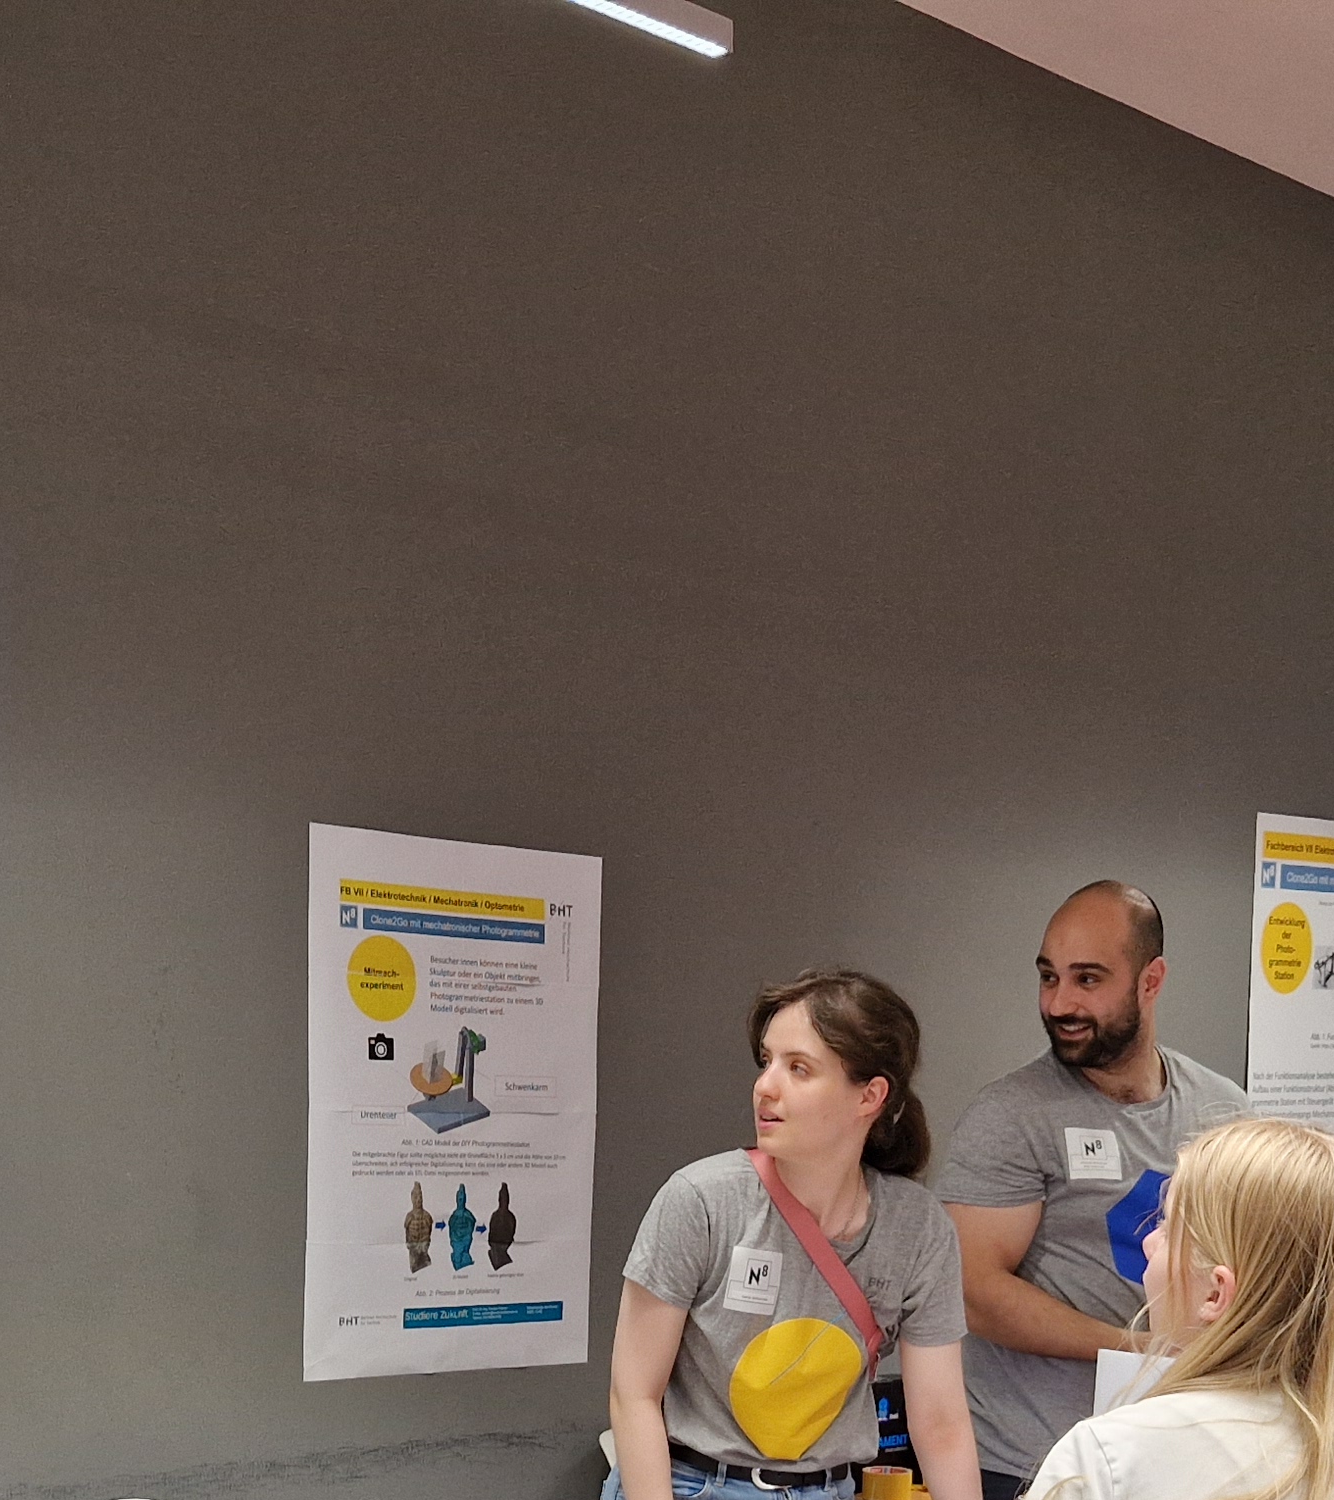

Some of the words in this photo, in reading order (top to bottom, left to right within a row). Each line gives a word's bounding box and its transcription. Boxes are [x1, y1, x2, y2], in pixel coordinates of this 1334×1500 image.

[340, 886, 352, 896] FB
[371, 889, 427, 903] Elektrotechnik
[433, 896, 478, 909] Mechatronik
[485, 900, 525, 913] Optometrie
[549, 903, 573, 918] BHT
[371, 914, 408, 927] Clone2Go
[410, 920, 422, 929] mit
[423, 920, 481, 933] mechatronischer
[481, 924, 540, 938] Photogrammetrie
[1269, 916, 1306, 929] Entwicklung
[1281, 930, 1292, 940] der
[479, 959, 504, 968] können
[520, 962, 538, 970] kleine
[429, 968, 456, 977] Skulptur
[485, 972, 505, 981] Objekt
[1274, 970, 1295, 980] Station
[360, 982, 404, 991] experiment
[430, 1004, 453, 1012] Modell
[505, 1082, 549, 1092] Schwenkarm
[869, 1276, 892, 1291] BHT
[339, 1316, 360, 1327] BHT
[879, 1434, 908, 1449] AMENT
